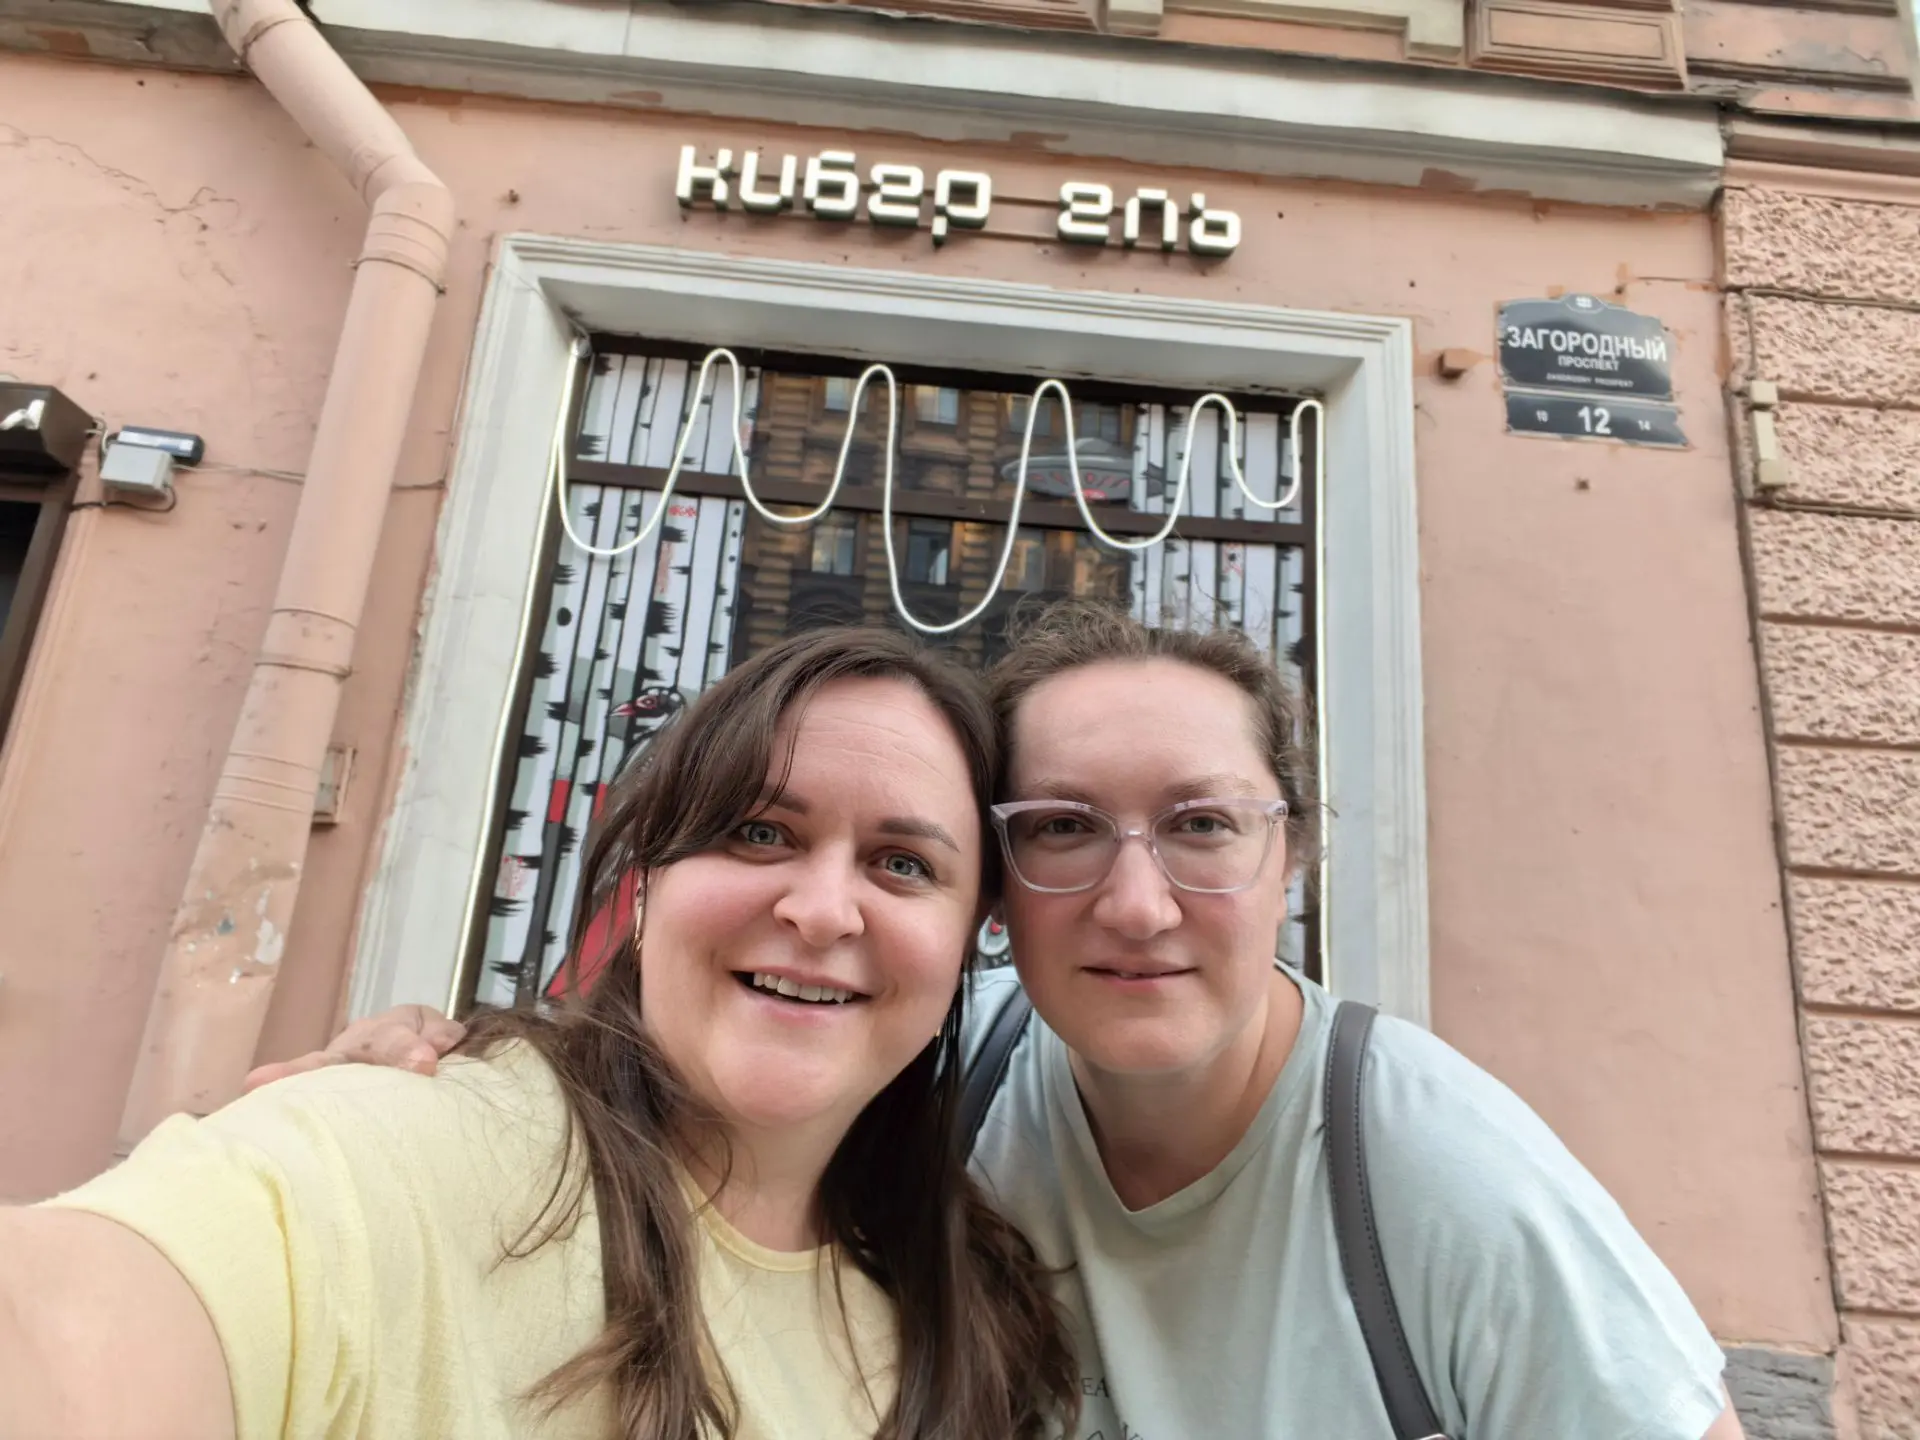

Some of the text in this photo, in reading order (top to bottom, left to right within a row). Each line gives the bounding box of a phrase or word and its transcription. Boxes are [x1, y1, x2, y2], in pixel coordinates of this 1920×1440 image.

[1507, 326, 1667, 362] ЗАГОРОДНЫЙ
[1557, 355, 1619, 371] ПРОСПЕКТ
[1577, 405, 1612, 434] 12
[1637, 419, 1651, 431] 14
